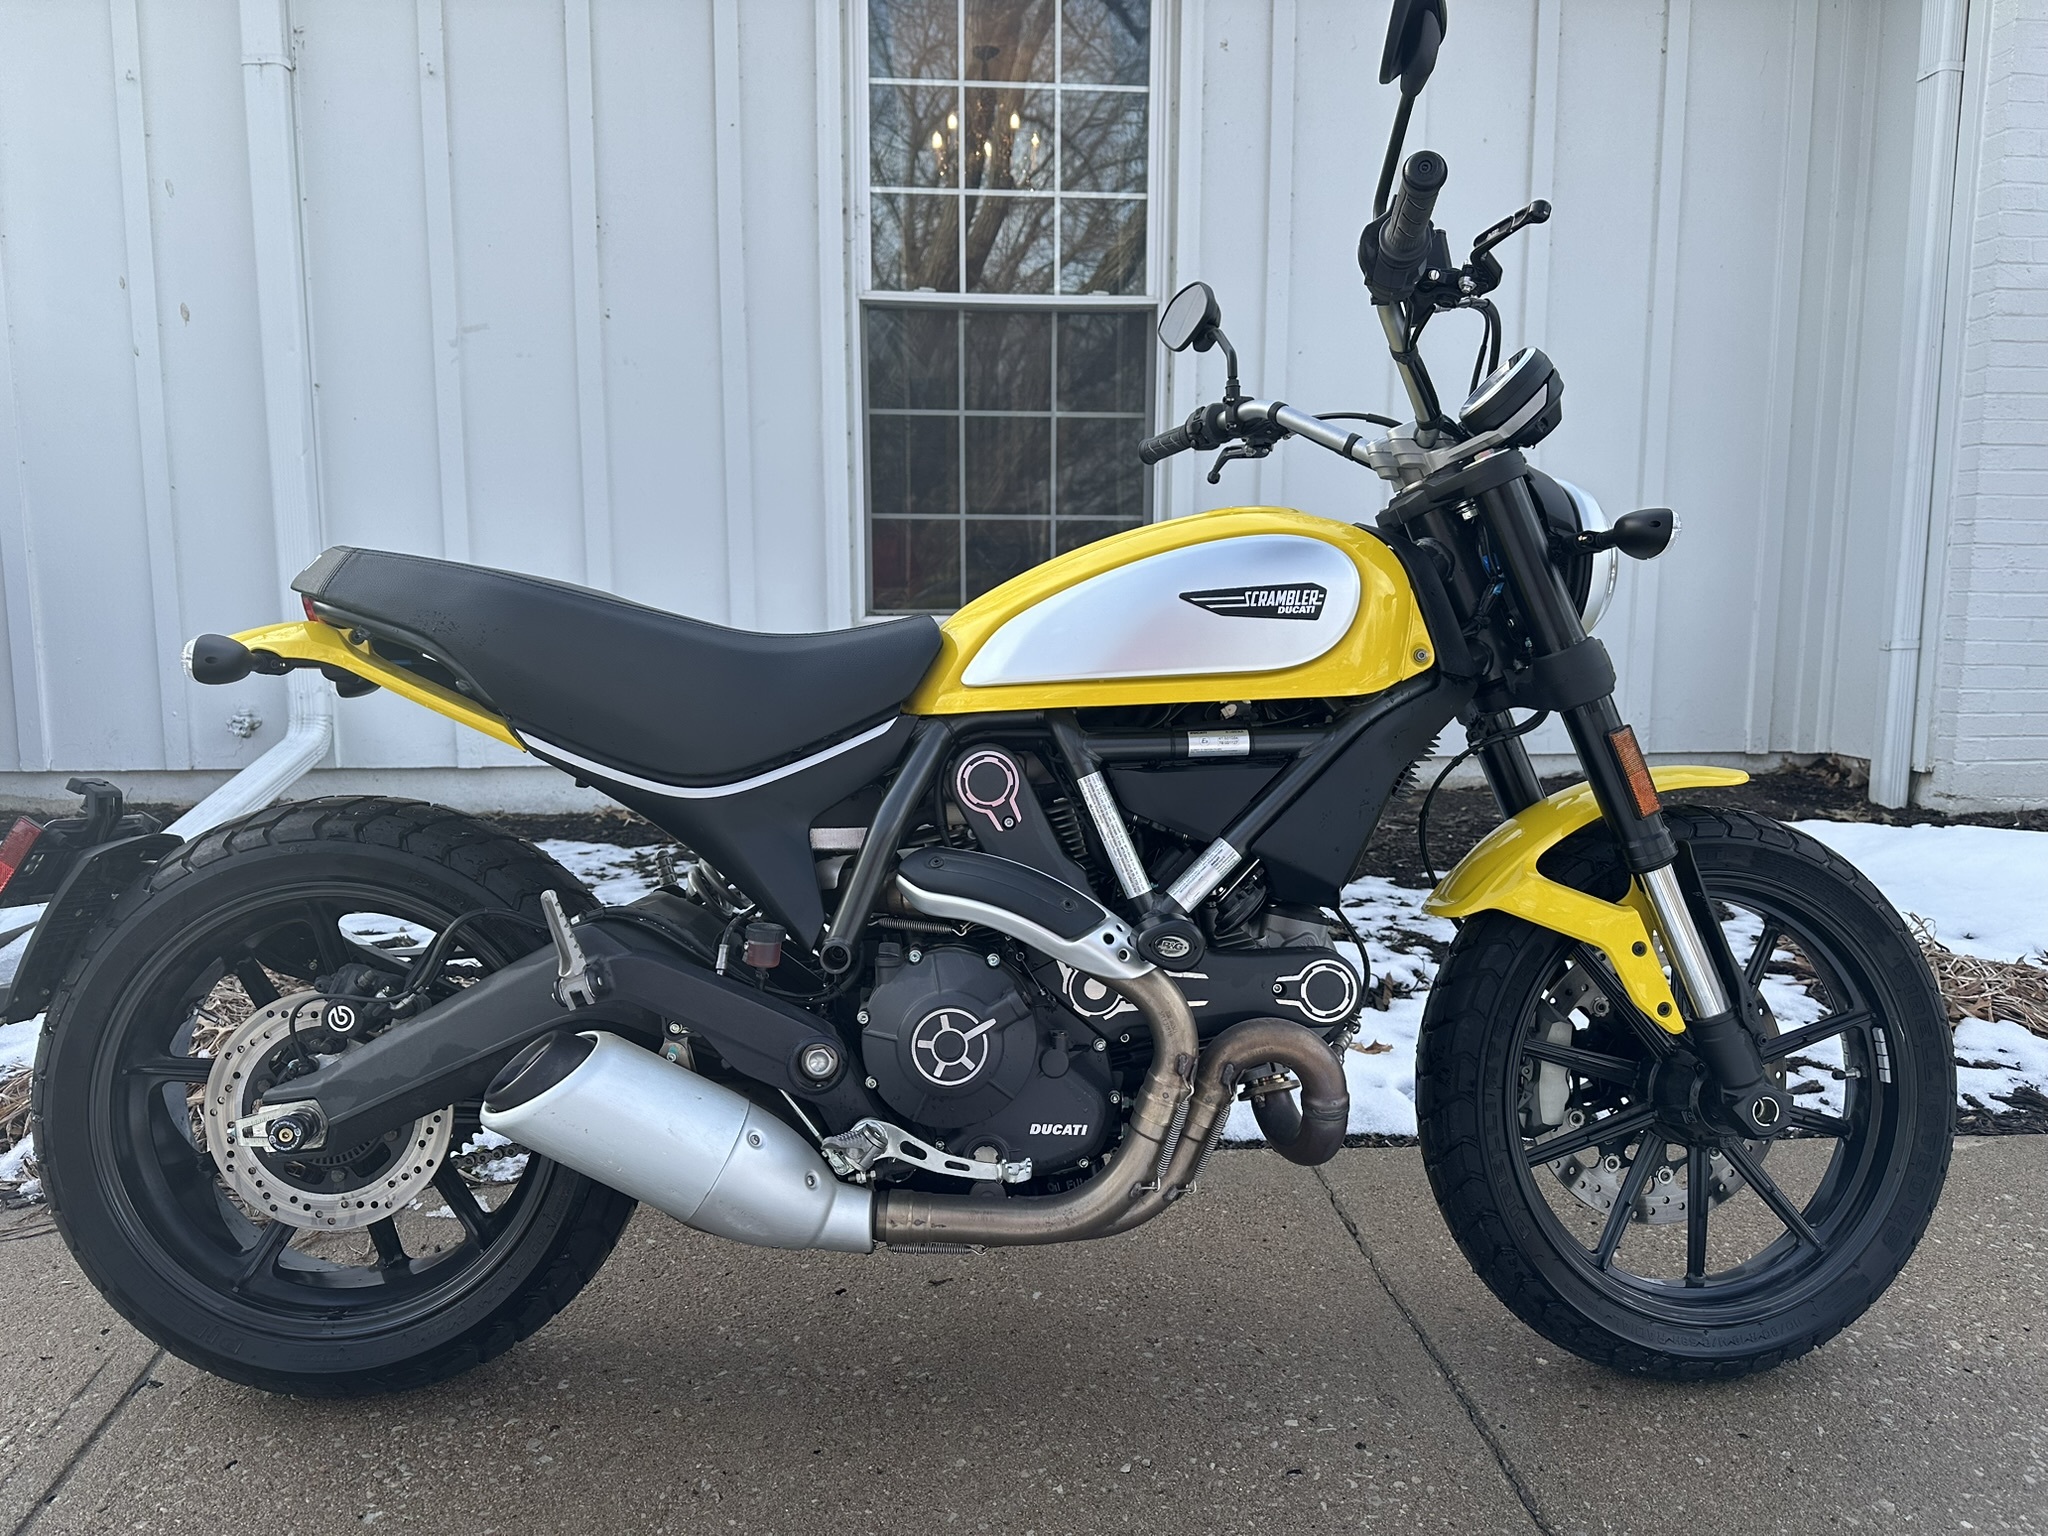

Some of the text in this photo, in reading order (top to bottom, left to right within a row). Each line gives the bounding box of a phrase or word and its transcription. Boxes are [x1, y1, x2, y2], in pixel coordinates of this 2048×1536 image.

[1244, 589, 1323, 607] SCRAMBLER
[1277, 605, 1315, 614] DUCATI
[1029, 1123, 1088, 1136] DUCATI
